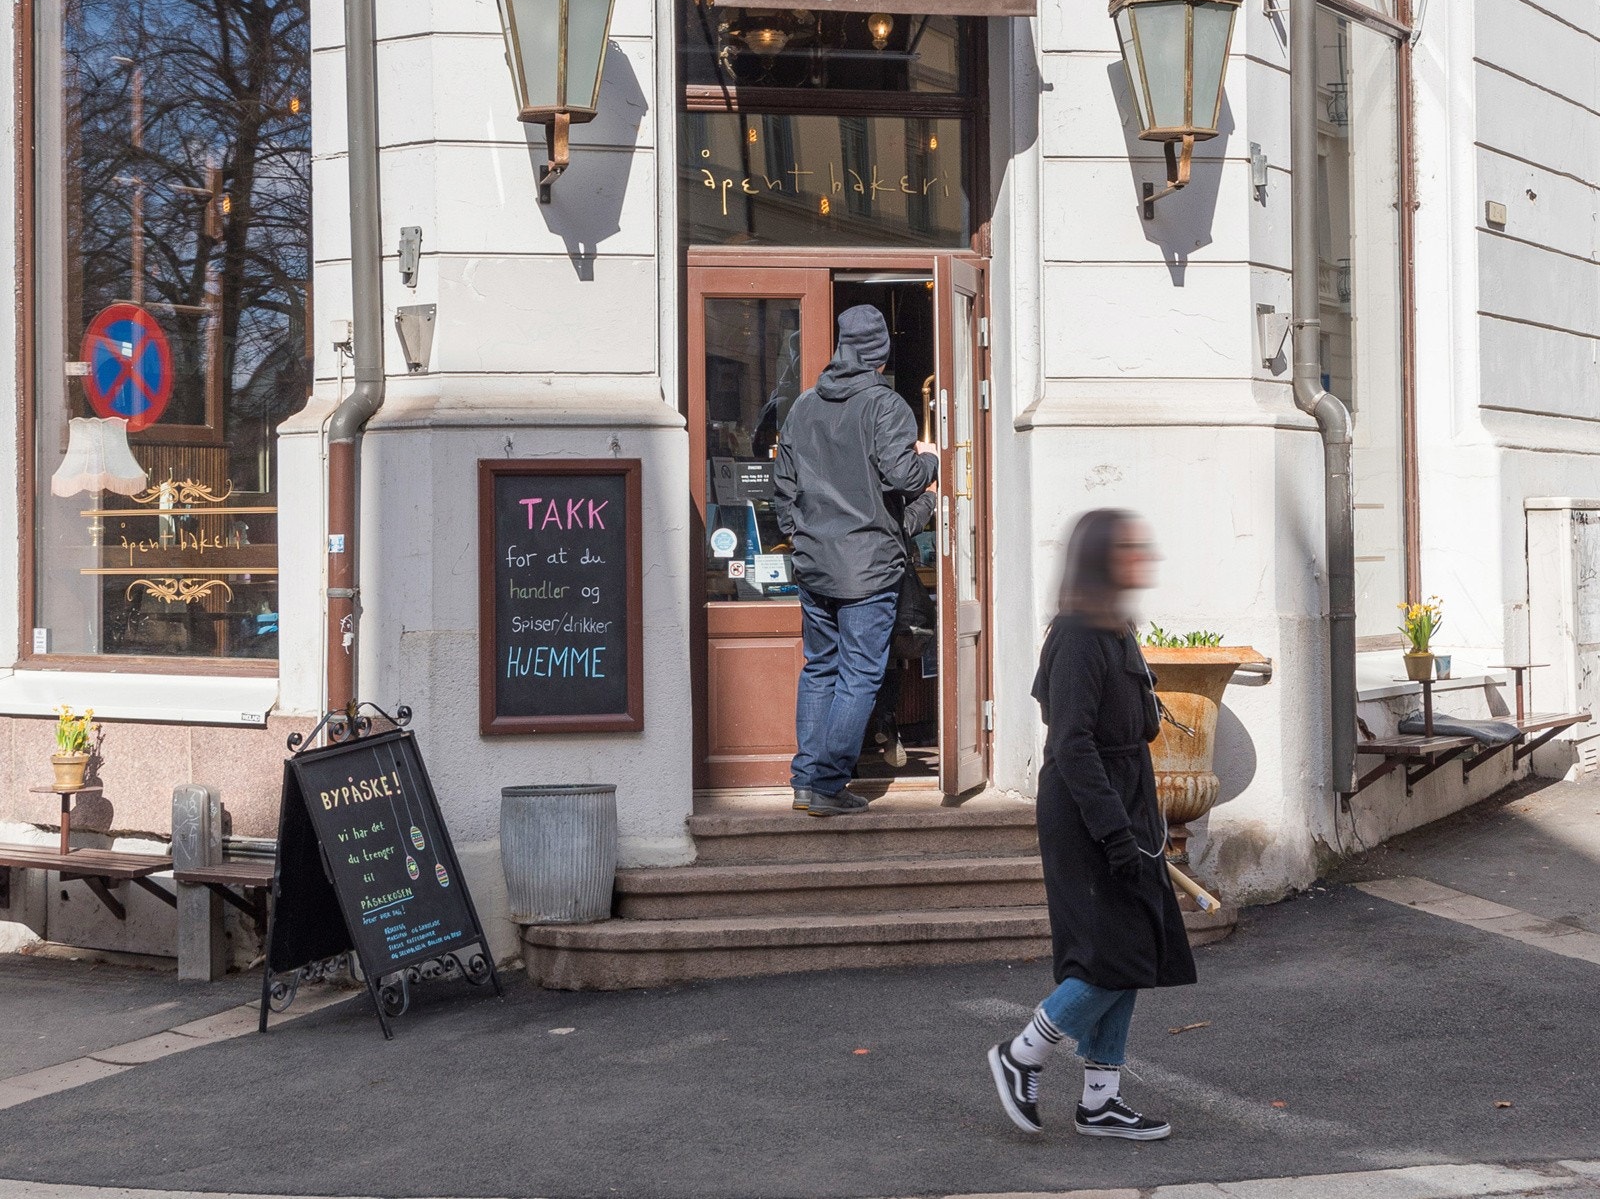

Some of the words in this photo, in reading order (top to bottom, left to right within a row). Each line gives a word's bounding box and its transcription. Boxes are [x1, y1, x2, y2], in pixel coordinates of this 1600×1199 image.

[700, 148, 814, 216] åpent
[829, 161, 950, 200] bakeri
[518, 497, 609, 531] TAKK
[120, 521, 174, 567] åpent
[505, 544, 538, 568] for
[546, 547, 568, 564] at
[580, 547, 606, 565] du
[509, 577, 570, 599] handler
[581, 586, 601, 604] og
[506, 645, 606, 678] HJEMME
[320, 771, 401, 810] BYPÅSKE!
[337, 829, 349, 842] vi
[352, 826, 369, 840] har
[371, 821, 385, 832] det
[347, 853, 361, 865] du
[362, 845, 395, 861] trenger
[363, 872, 376, 883] til
[360, 887, 413, 910] PÅSKEKOSEN
